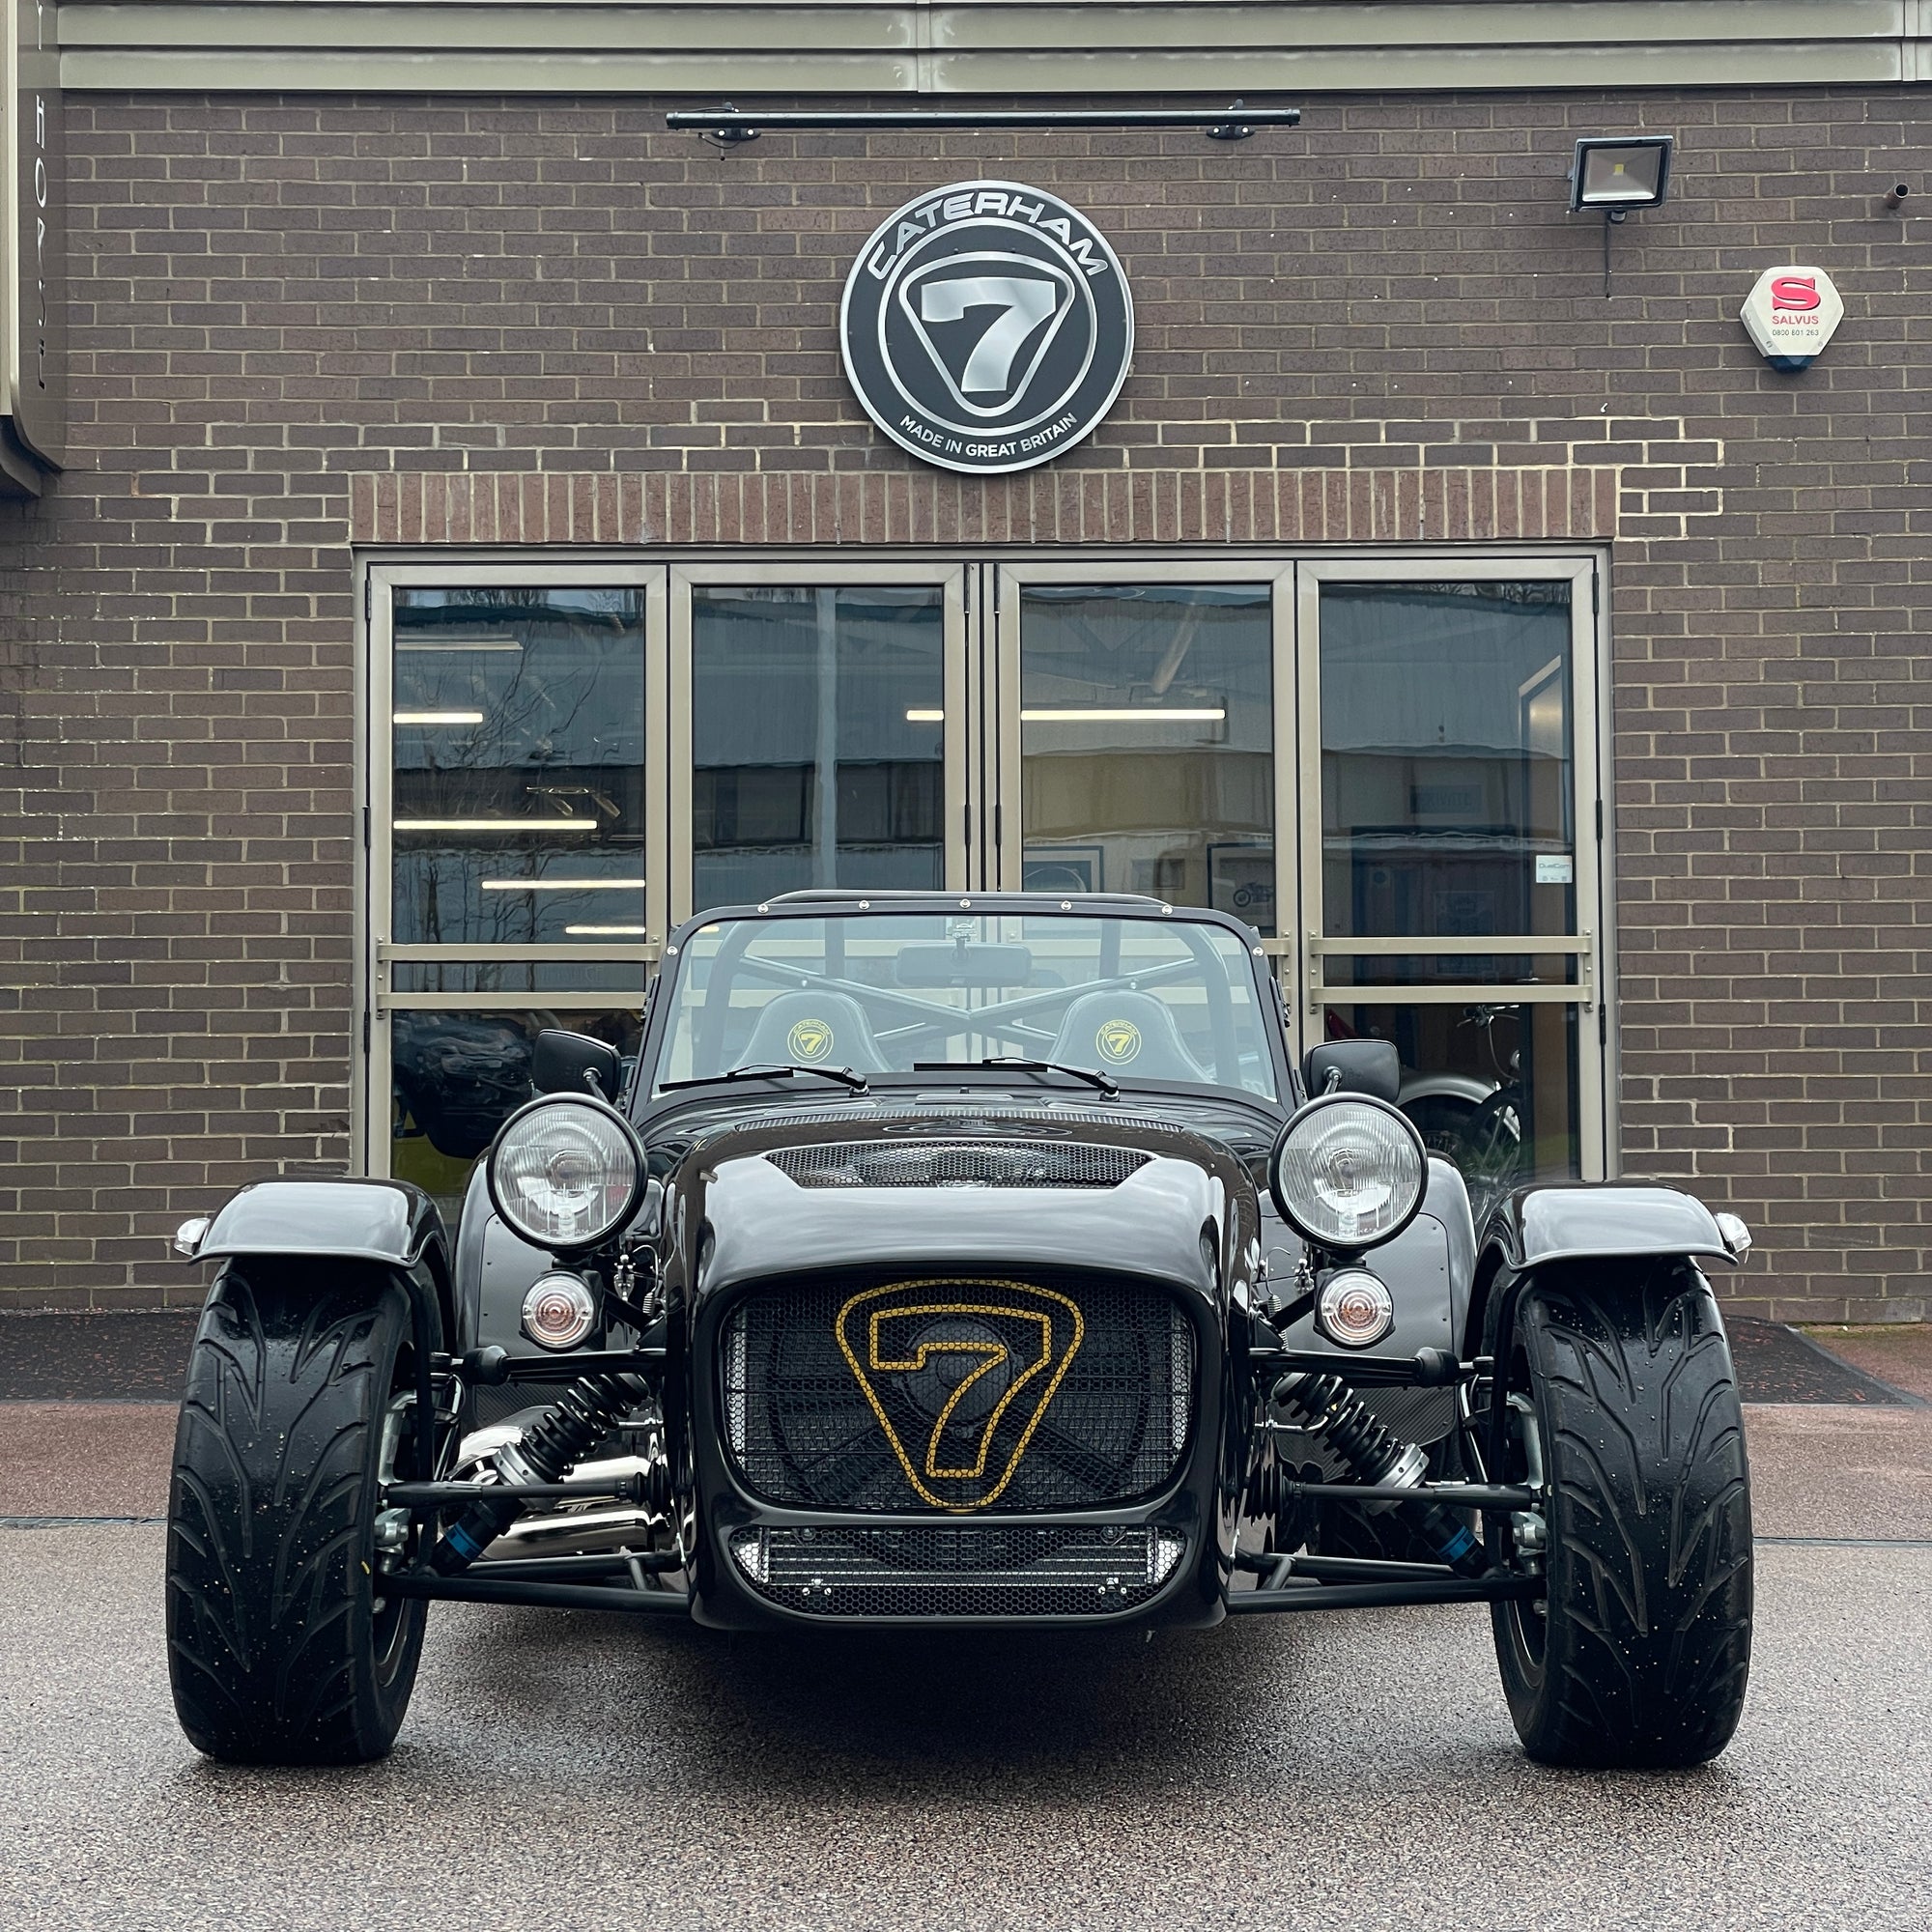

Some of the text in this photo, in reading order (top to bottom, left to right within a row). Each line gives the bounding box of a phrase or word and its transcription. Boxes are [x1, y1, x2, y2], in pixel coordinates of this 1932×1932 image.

[867, 191, 1108, 280] CATERHAM
[1771, 276, 1821, 311] S
[921, 276, 1056, 392] 7
[1772, 315, 1819, 325] SALVUS
[900, 412, 1078, 458] MADE IN GREAT BRITAIN
[800, 1033, 823, 1052] 7
[1108, 1034, 1130, 1053] 7
[868, 1303, 1052, 1478] 7
